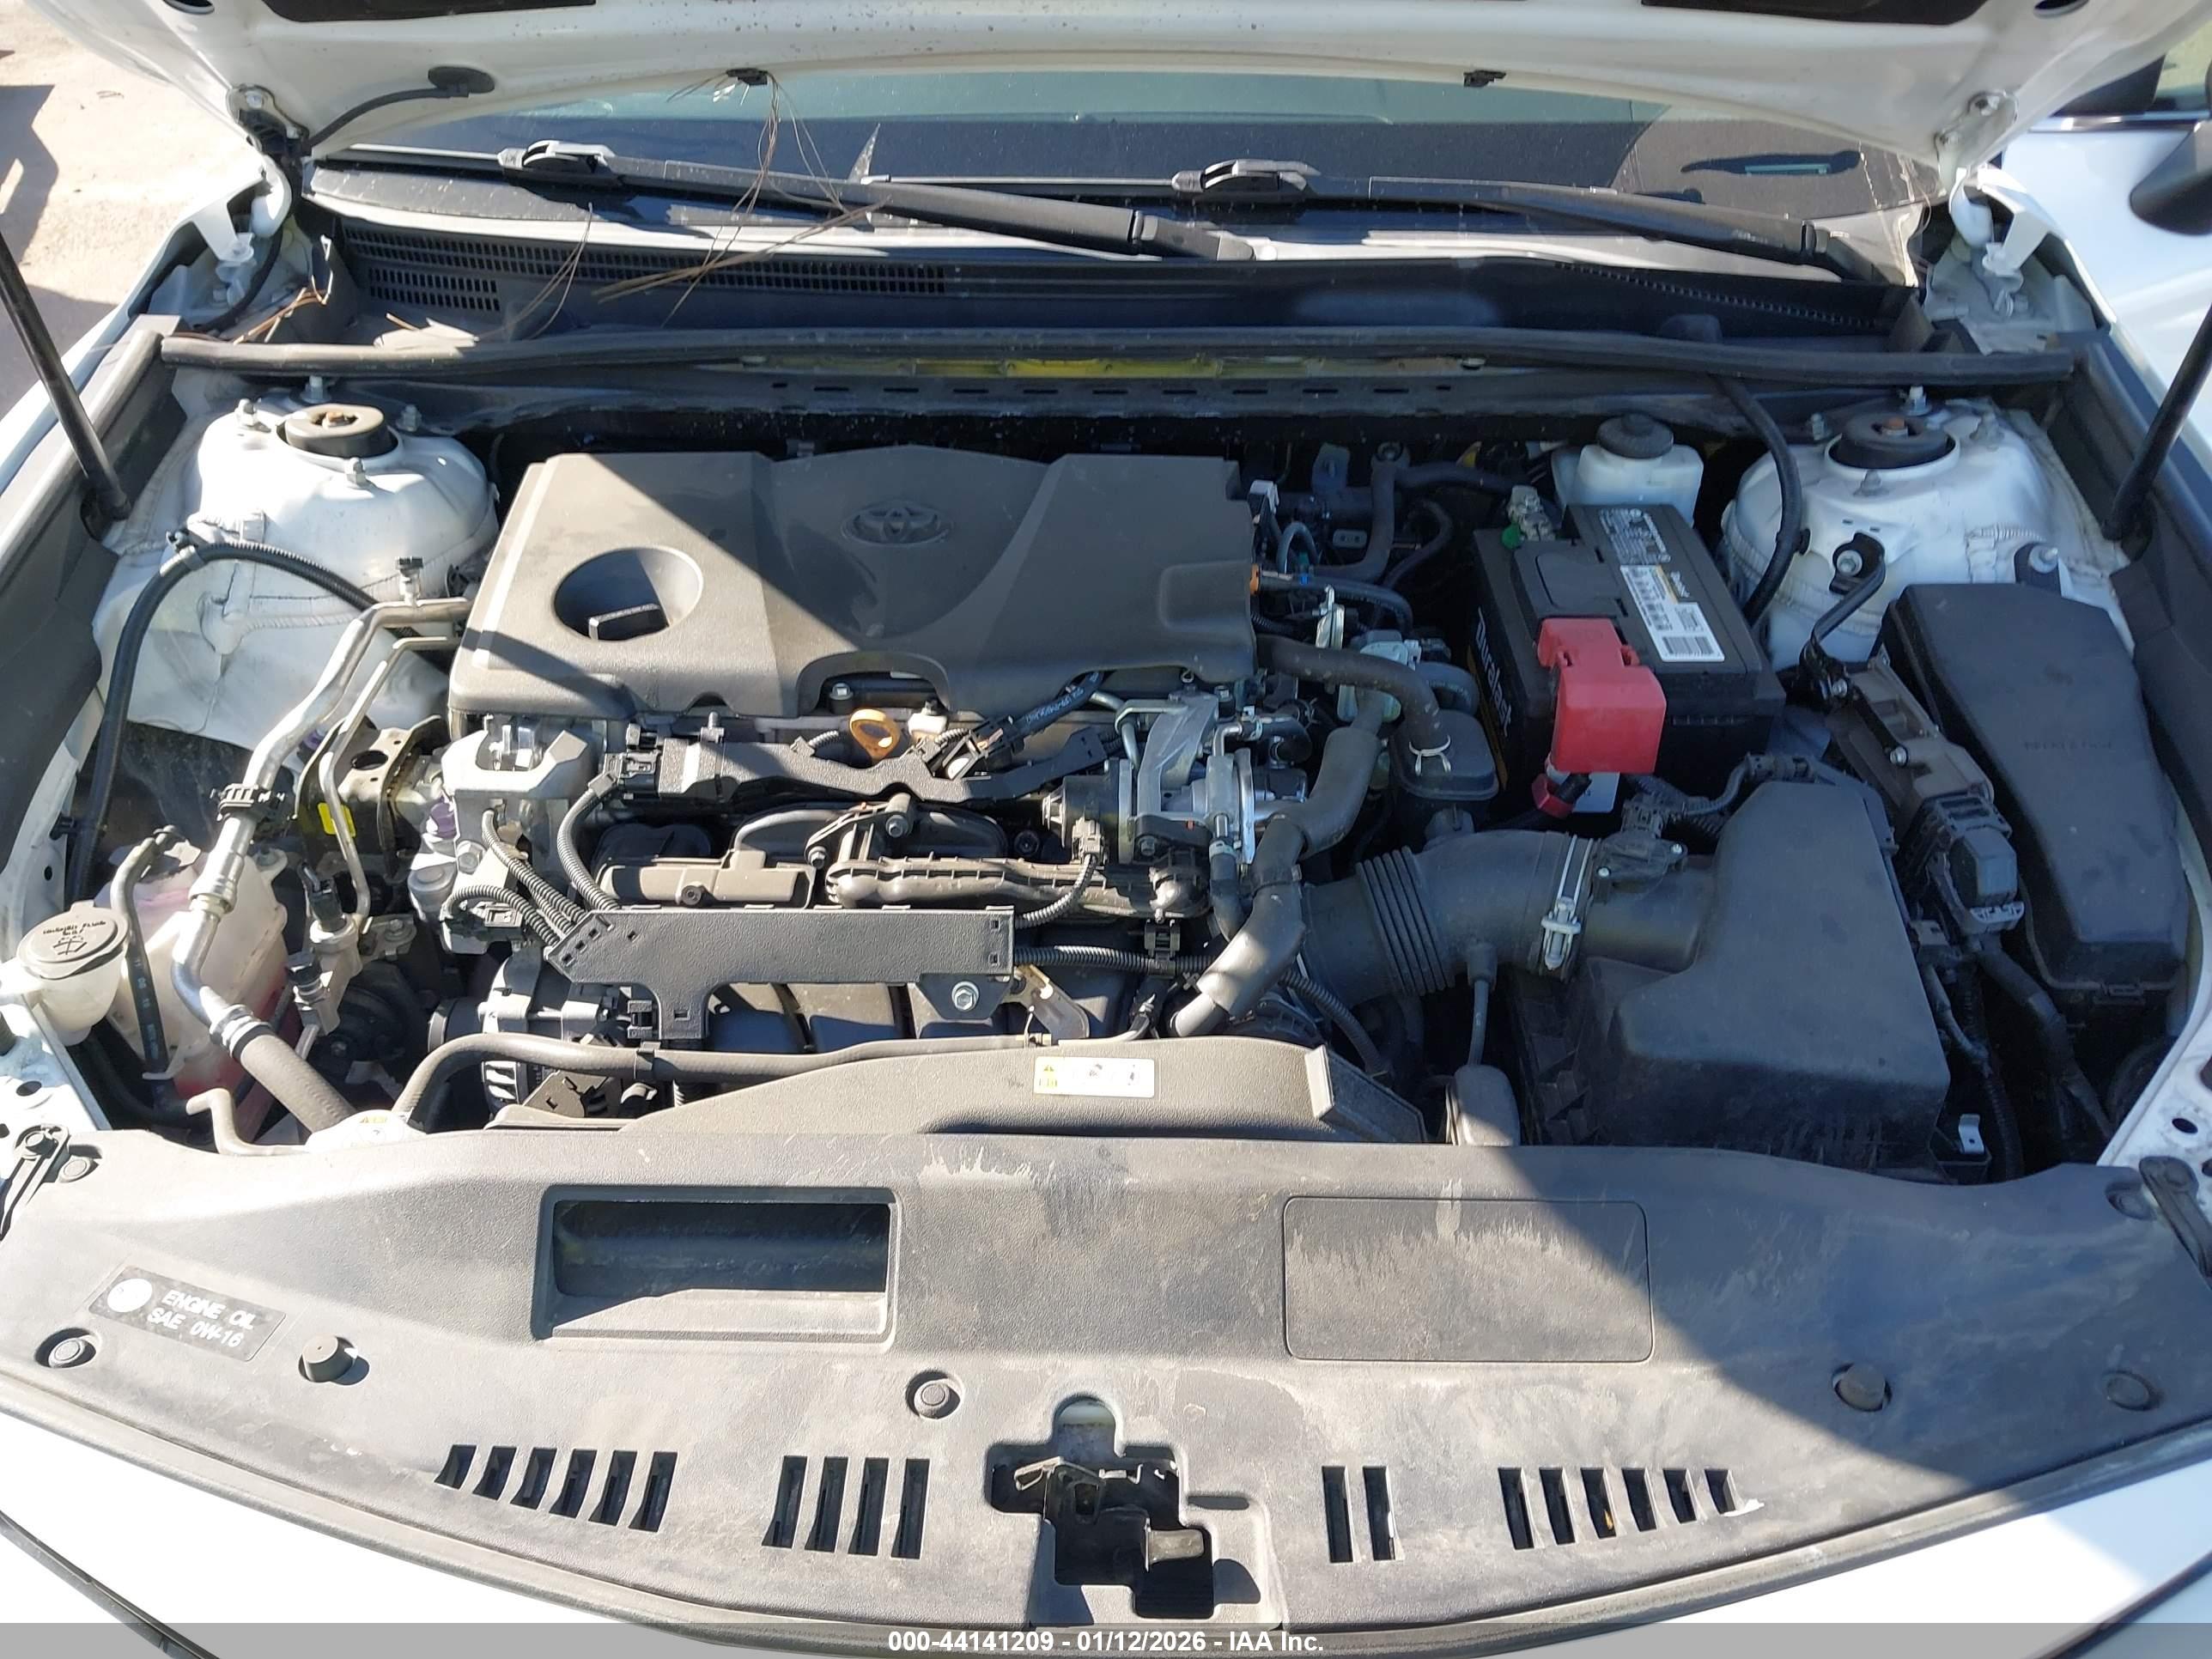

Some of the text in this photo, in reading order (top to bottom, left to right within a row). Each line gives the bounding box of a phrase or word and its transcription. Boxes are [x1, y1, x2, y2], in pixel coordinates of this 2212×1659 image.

[1475, 605, 1512, 738] Duralast
[147, 1307, 245, 1347] SAE 0W-16
[161, 1289, 257, 1330] ENGINE OIL
